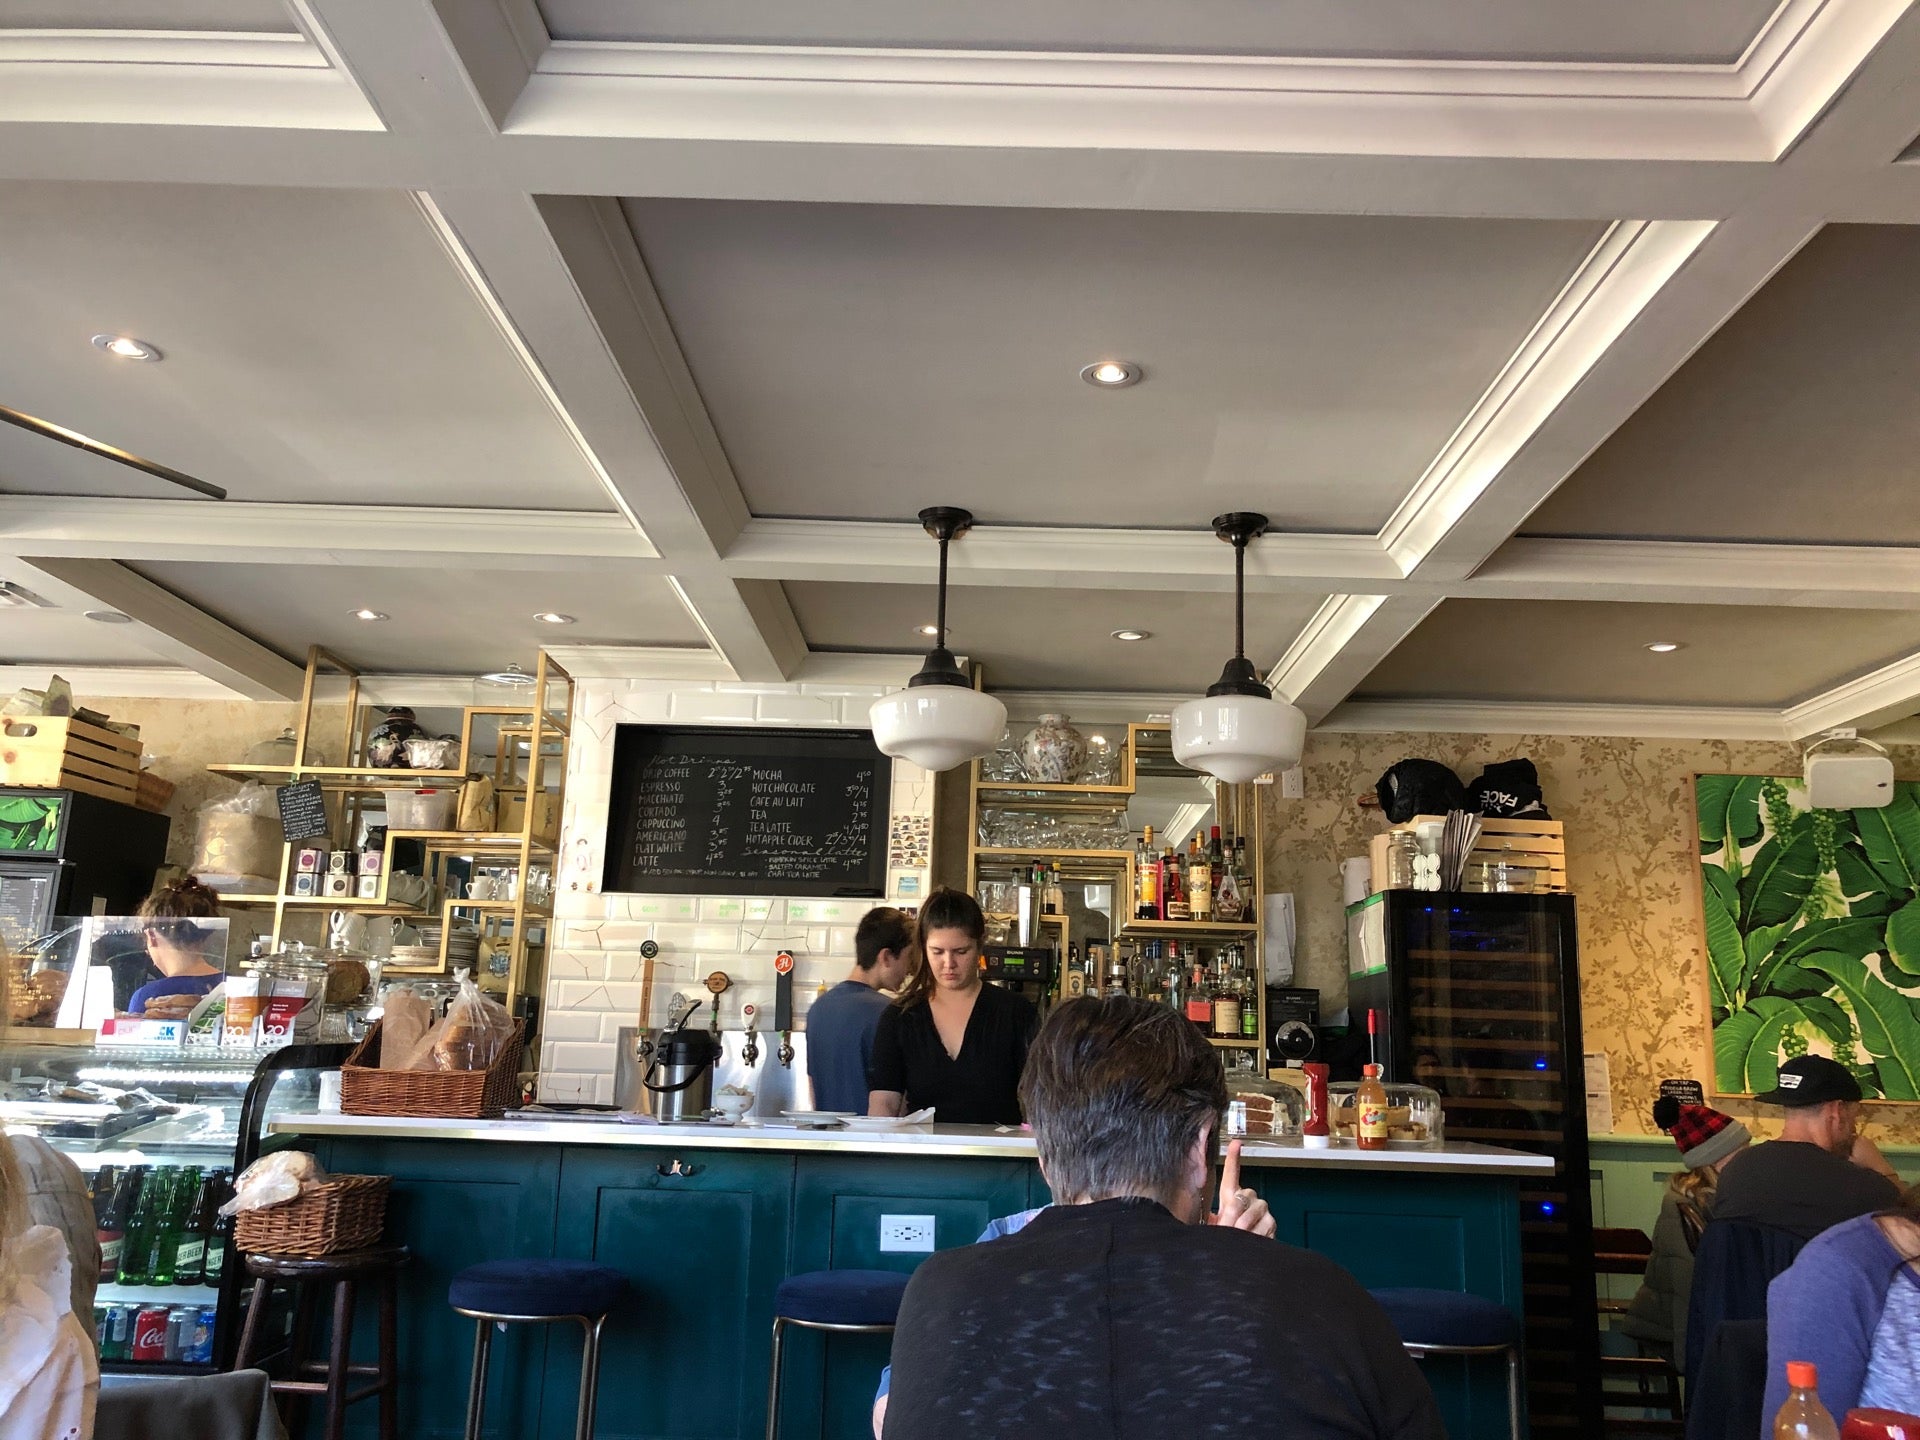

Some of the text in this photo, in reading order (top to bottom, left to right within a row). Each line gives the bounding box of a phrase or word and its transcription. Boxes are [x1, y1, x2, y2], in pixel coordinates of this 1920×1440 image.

[664, 767, 690, 778] COFFEE
[752, 769, 783, 780] MOCHA
[640, 781, 681, 793] ESPRESSO
[639, 794, 684, 804] MACCHIATO
[750, 796, 804, 807] CAFE AU LAIT
[1480, 790, 1518, 807] FACE
[638, 805, 677, 817] CORTADO
[750, 809, 767, 820] TEA
[636, 818, 686, 829] CAPPUCCINO
[766, 822, 792, 833] LATTE
[635, 830, 687, 841] AMERICANO
[632, 856, 660, 867] LATTE
[267, 1025, 284, 1036] 20
[187, 1246, 203, 1258] BEER
